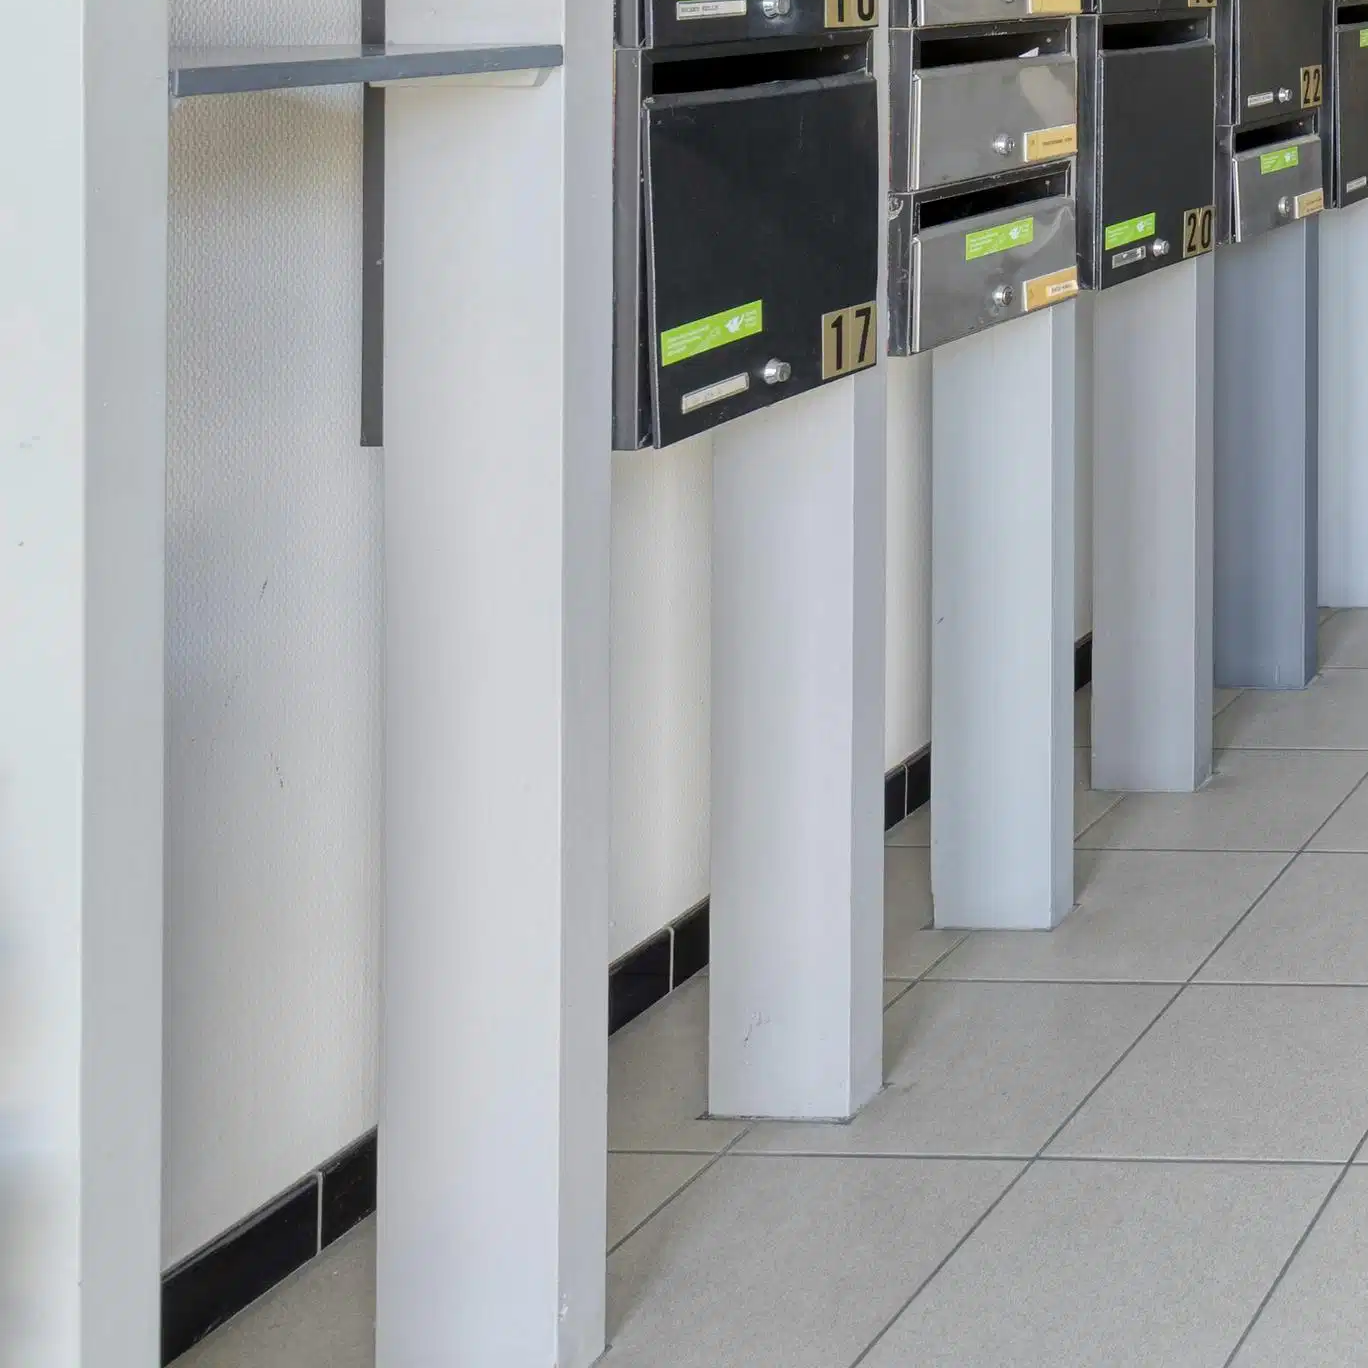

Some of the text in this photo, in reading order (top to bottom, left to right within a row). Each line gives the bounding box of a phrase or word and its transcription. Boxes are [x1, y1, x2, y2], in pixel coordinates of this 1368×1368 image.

[1303, 69, 1321, 104] 22
[1187, 210, 1212, 253] 20
[831, 307, 871, 371] 17
